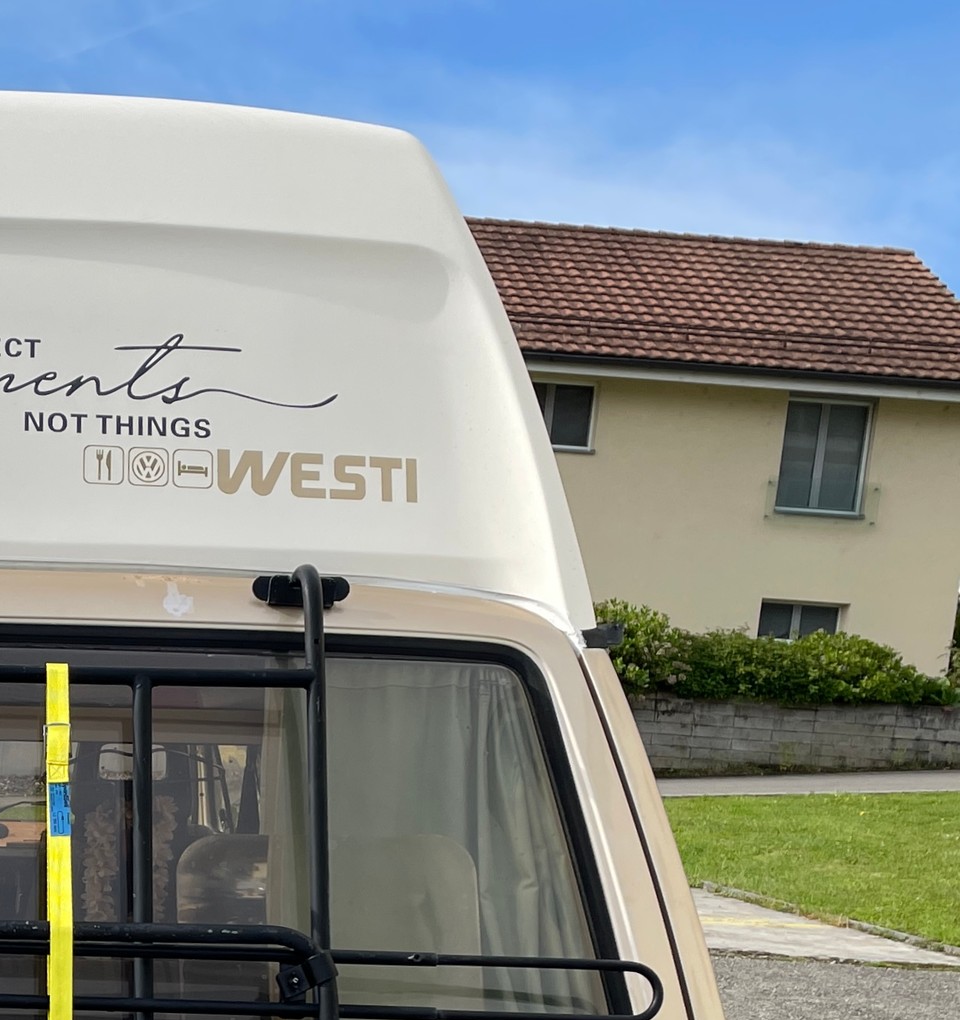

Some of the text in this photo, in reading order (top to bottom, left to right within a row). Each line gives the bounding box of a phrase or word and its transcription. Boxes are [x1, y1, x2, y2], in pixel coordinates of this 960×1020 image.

[24, 412, 212, 438] NOT THINGS
[217, 449, 418, 503] WESTI
